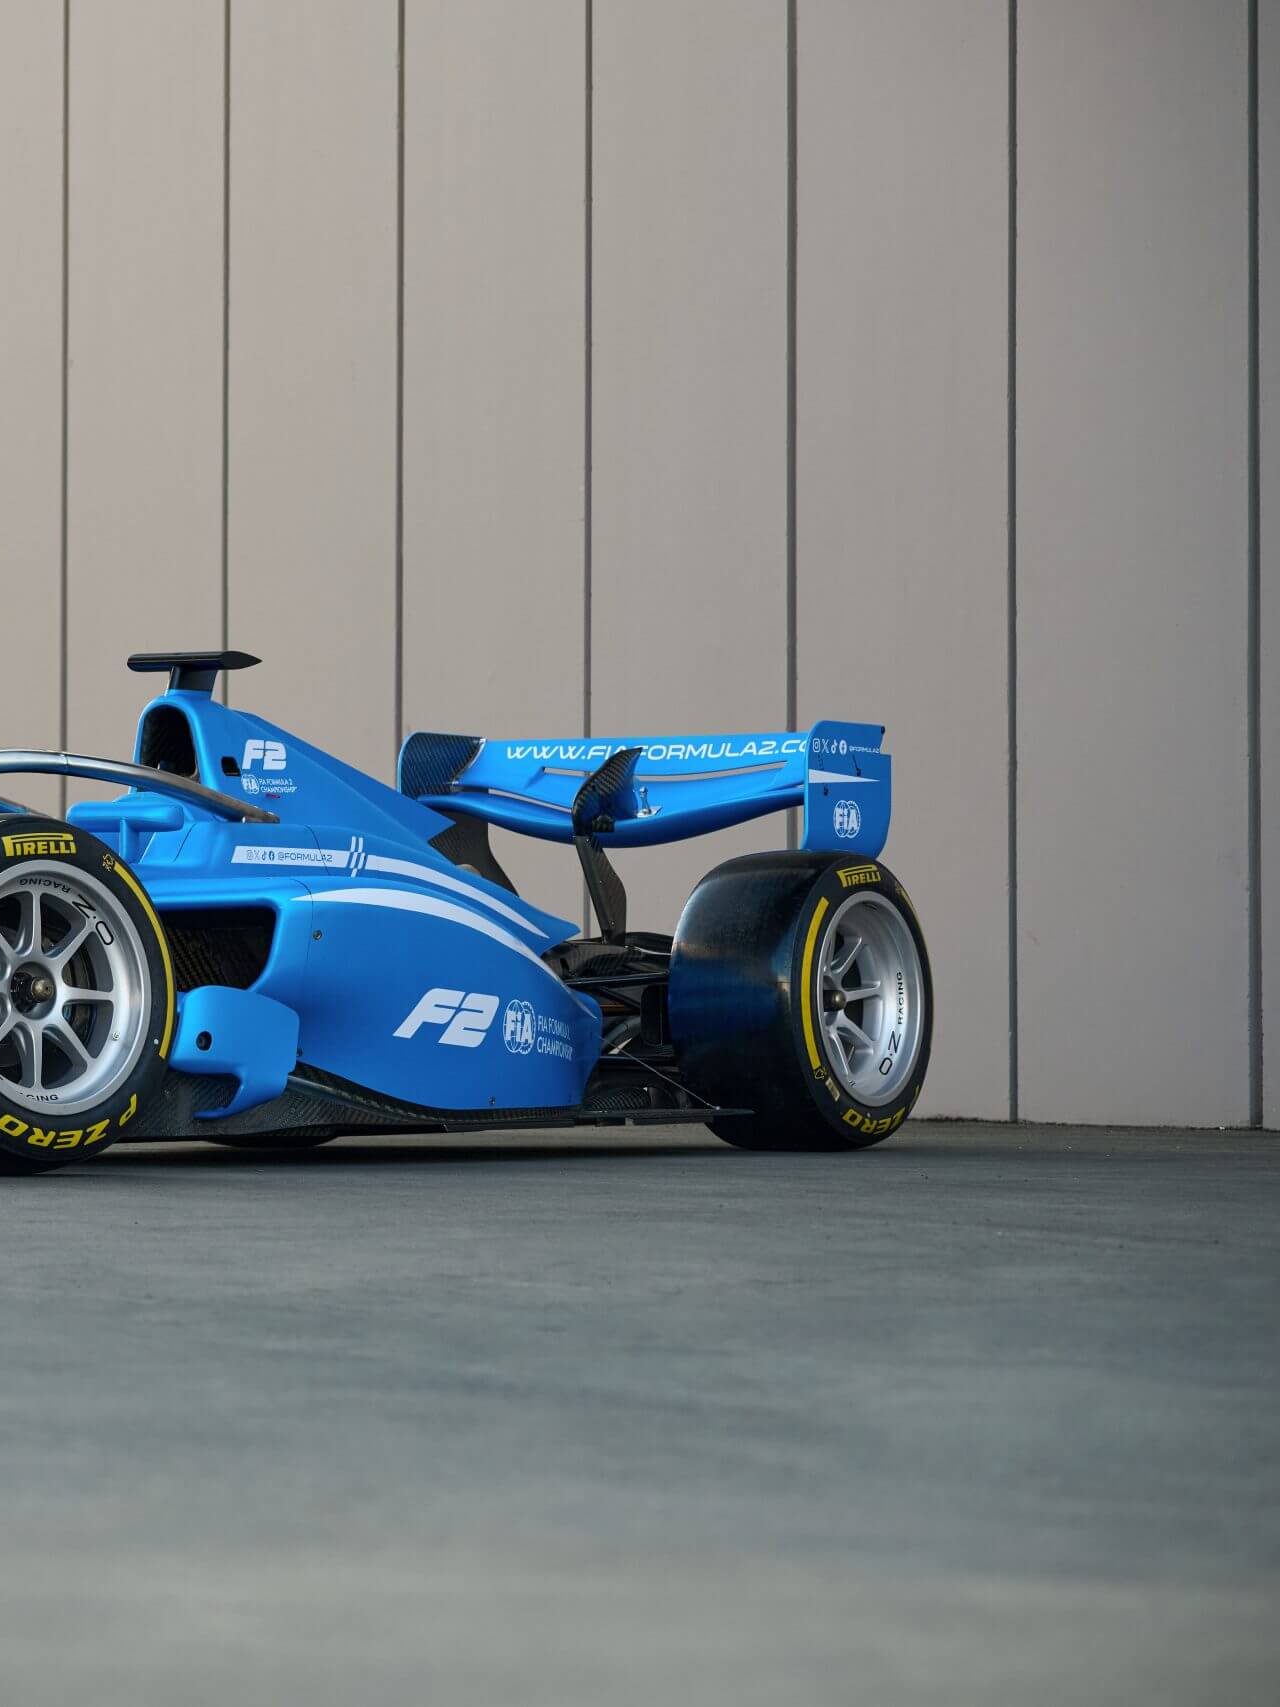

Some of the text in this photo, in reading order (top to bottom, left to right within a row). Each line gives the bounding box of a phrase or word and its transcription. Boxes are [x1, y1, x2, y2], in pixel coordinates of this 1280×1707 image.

[242, 739, 287, 770] F2
[835, 807, 859, 831] FIA
[2, 832, 77, 857] PIRELLI
[277, 852, 333, 863] @FORMULA2
[20, 878, 72, 893] RACING
[836, 864, 881, 888] PIRELLI
[896, 972, 904, 1025] RACING
[392, 988, 500, 1048] F2
[504, 1009, 534, 1044] FIA
[537, 1016, 549, 1033] FIA
[119, 1093, 138, 1127] P
[842, 1106, 906, 1135] ZERO
